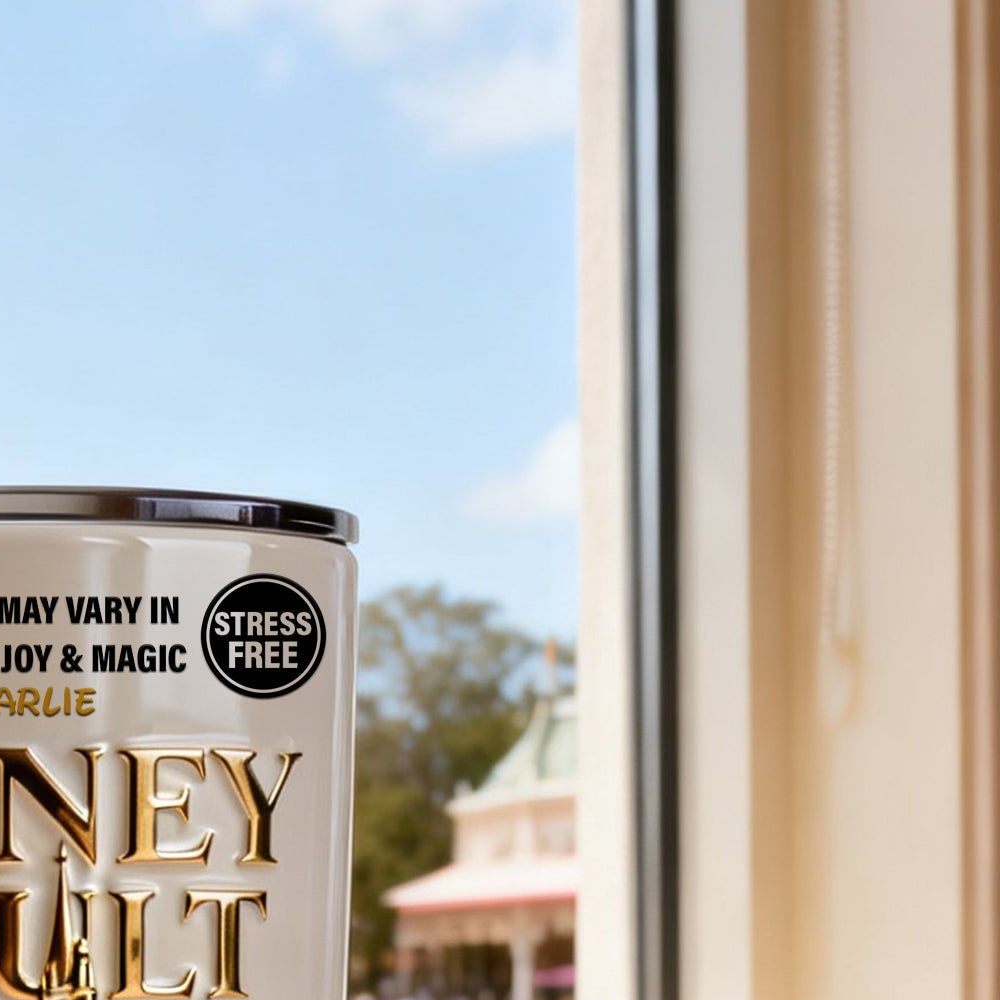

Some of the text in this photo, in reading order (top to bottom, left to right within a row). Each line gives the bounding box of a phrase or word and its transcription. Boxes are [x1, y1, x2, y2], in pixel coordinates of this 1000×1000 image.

[66, 596, 142, 624] VARY
[150, 596, 179, 624] IN
[214, 611, 312, 636] STRESS
[1, 644, 52, 673] JOY
[60, 644, 84, 673] &
[92, 644, 187, 673] MAGIC
[228, 641, 298, 668] FREE
